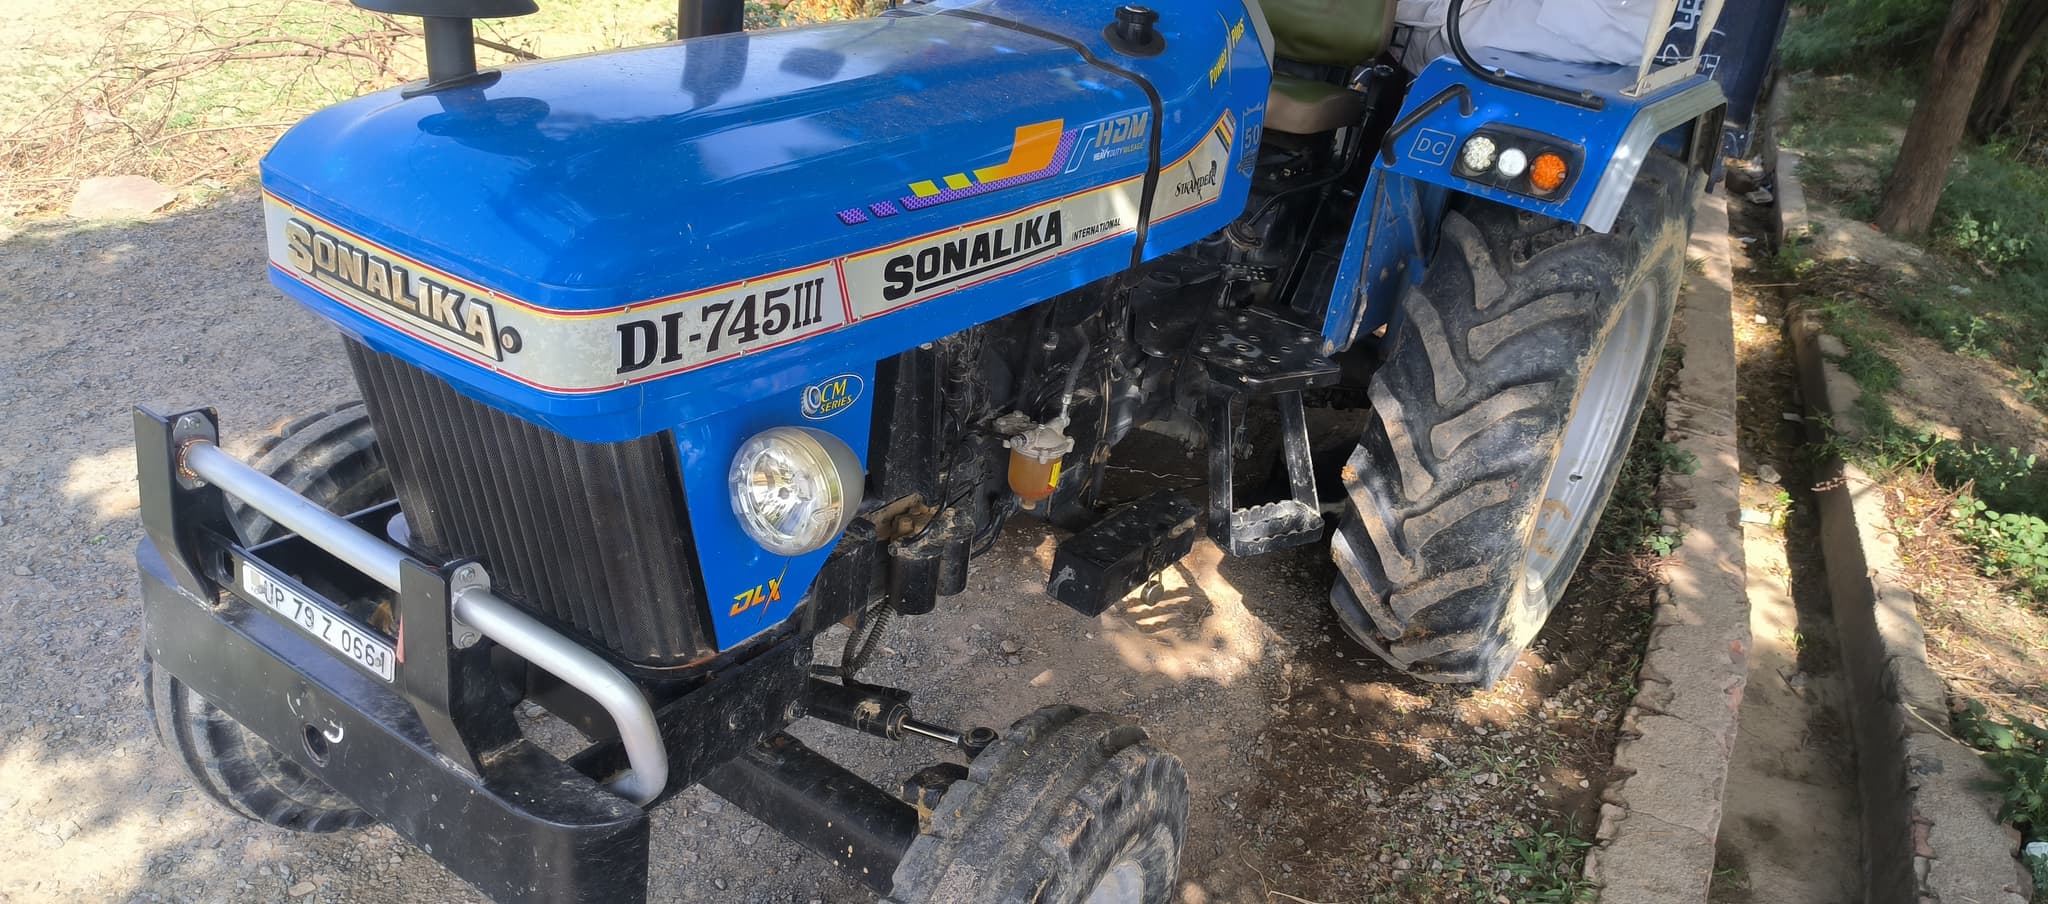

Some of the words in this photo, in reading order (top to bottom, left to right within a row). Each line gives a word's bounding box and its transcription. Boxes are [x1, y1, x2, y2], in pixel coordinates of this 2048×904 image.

[1095, 111, 1148, 148] HDM
[1245, 124, 1260, 148] 50
[1416, 137, 1447, 157] DC
[1093, 146, 1111, 161] HEAVY
[1175, 160, 1217, 199] SIKANDER
[883, 210, 1062, 301] SONALIKA
[1072, 217, 1121, 241] INTERNATIONAL
[286, 217, 503, 362] SONALIKA
[820, 394, 853, 414] SERIES
[821, 379, 847, 403] CM
[729, 566, 788, 620] DLX
[264, 580, 285, 609] UP
[293, 598, 315, 630] 79
[322, 615, 332, 642] Z
[341, 630, 385, 673] 0661
